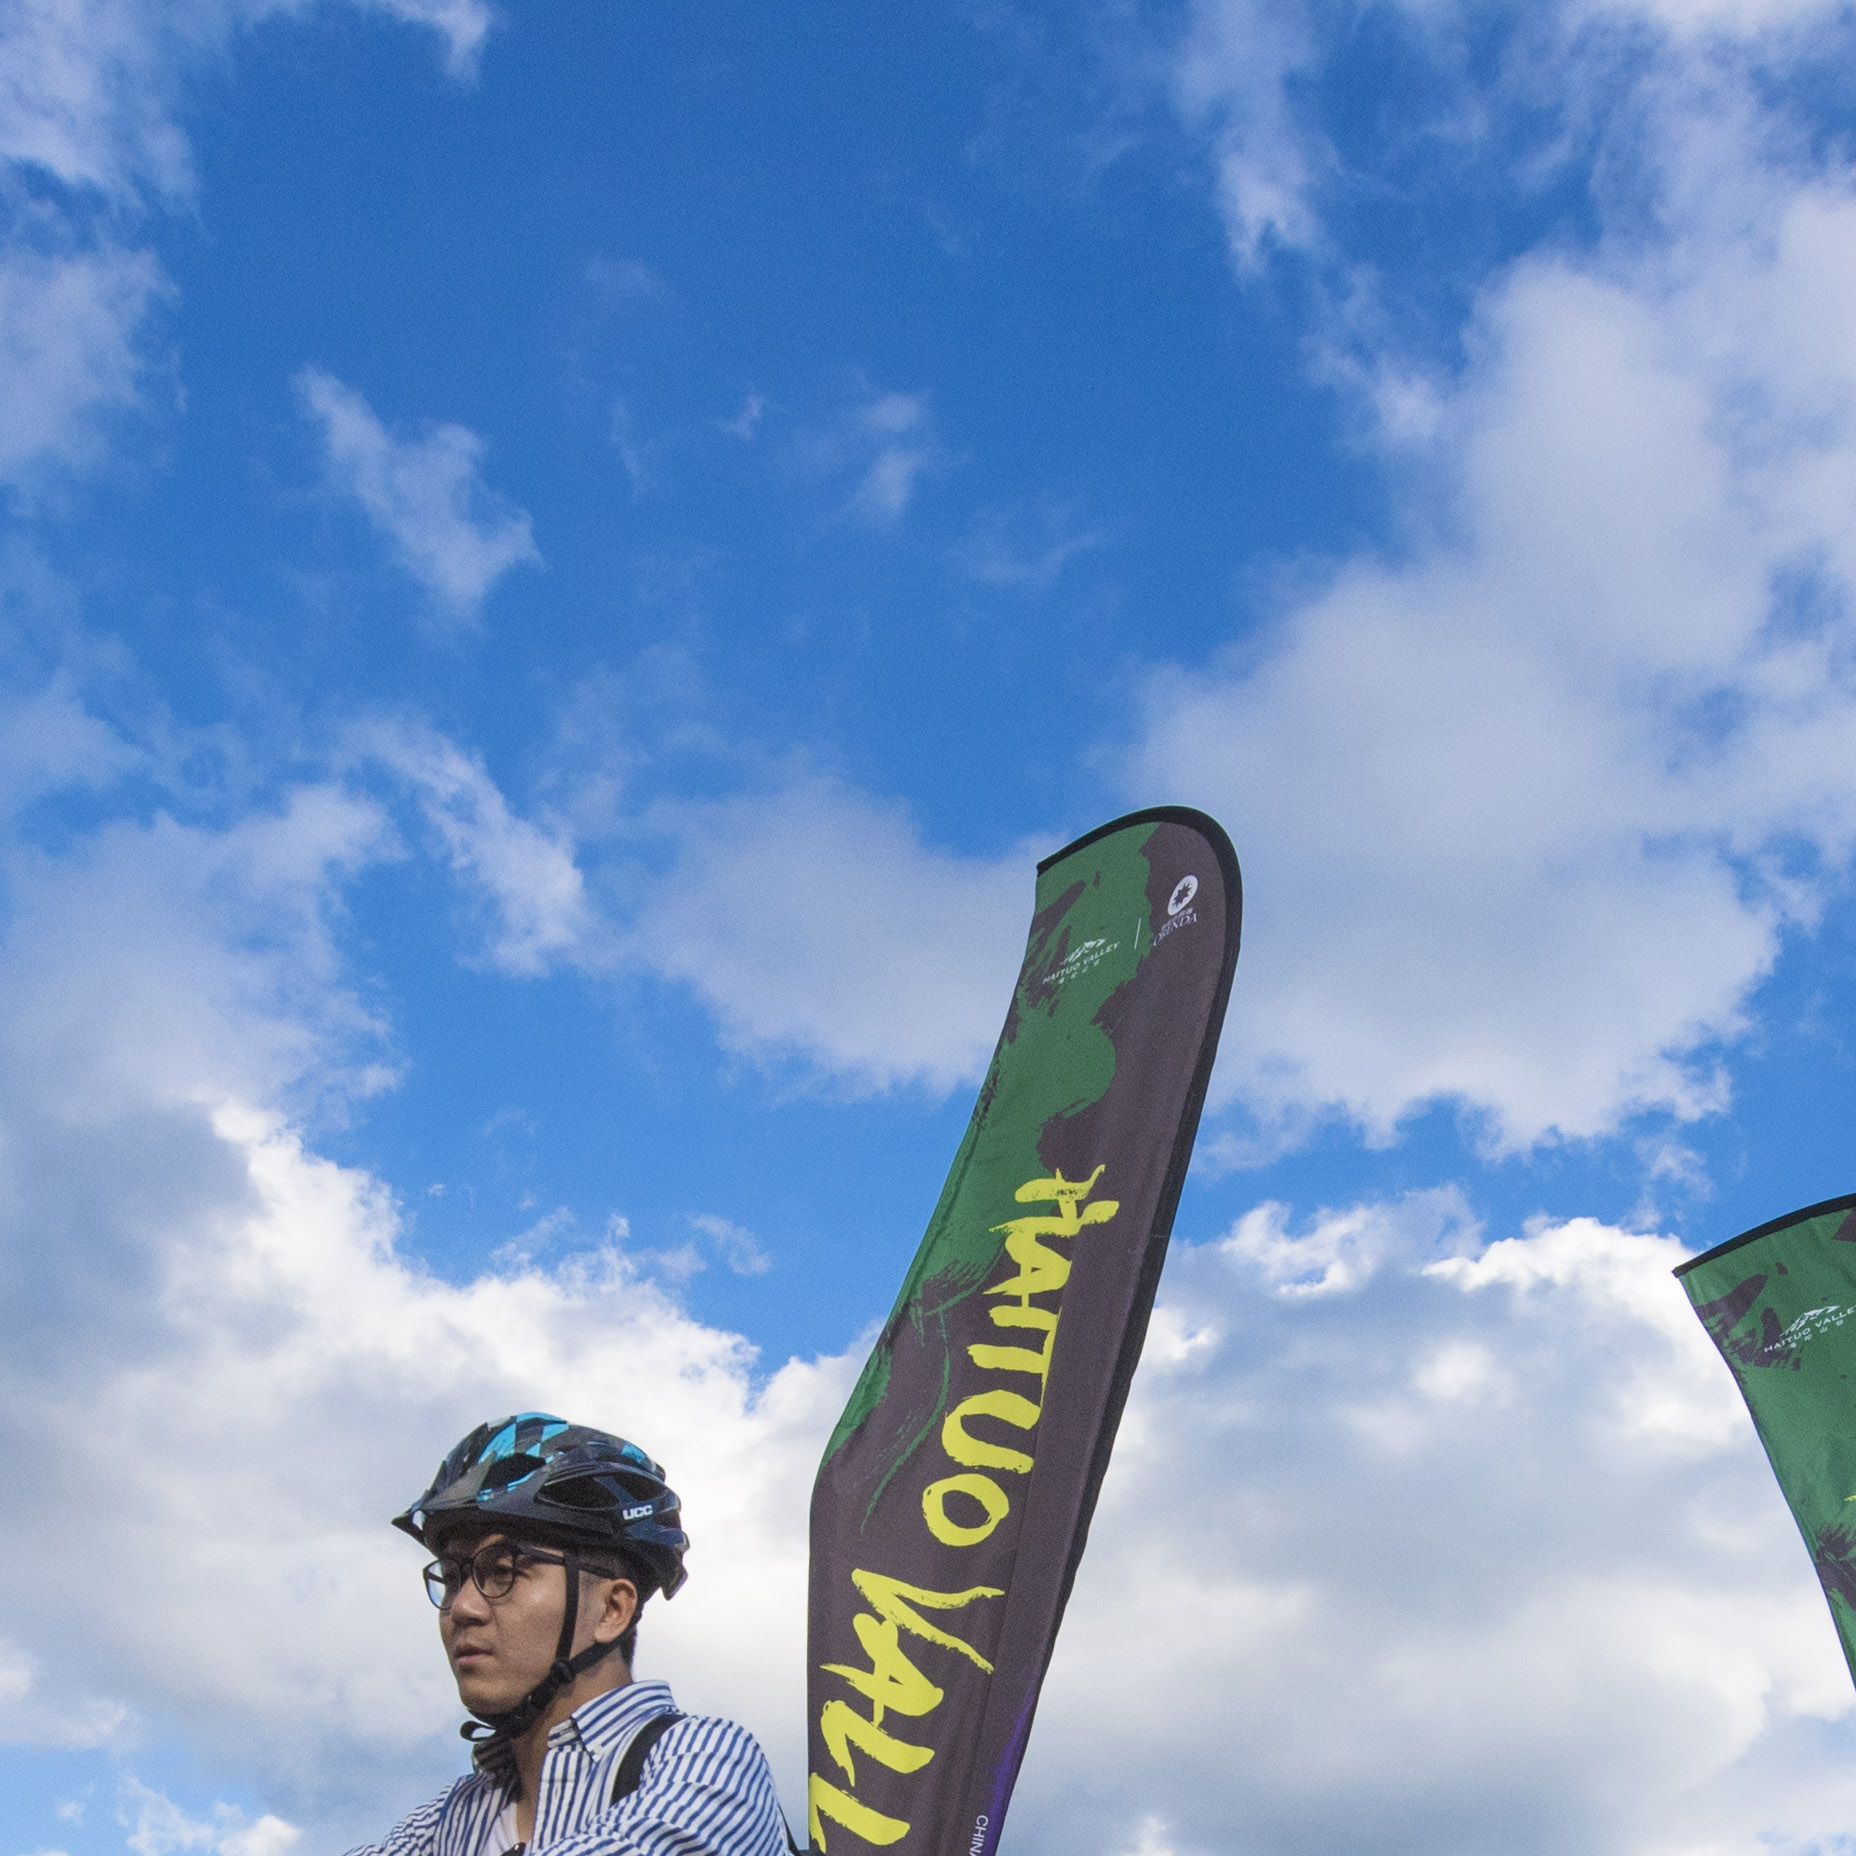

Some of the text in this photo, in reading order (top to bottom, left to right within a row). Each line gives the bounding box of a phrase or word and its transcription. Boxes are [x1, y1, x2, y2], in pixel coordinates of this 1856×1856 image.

[1084, 942, 1120, 965] VALLEY
[1763, 1326, 1811, 1353] HAITUO
[622, 1504, 654, 1521] UCC
[809, 1164, 1119, 1854] HAITUO VALL
